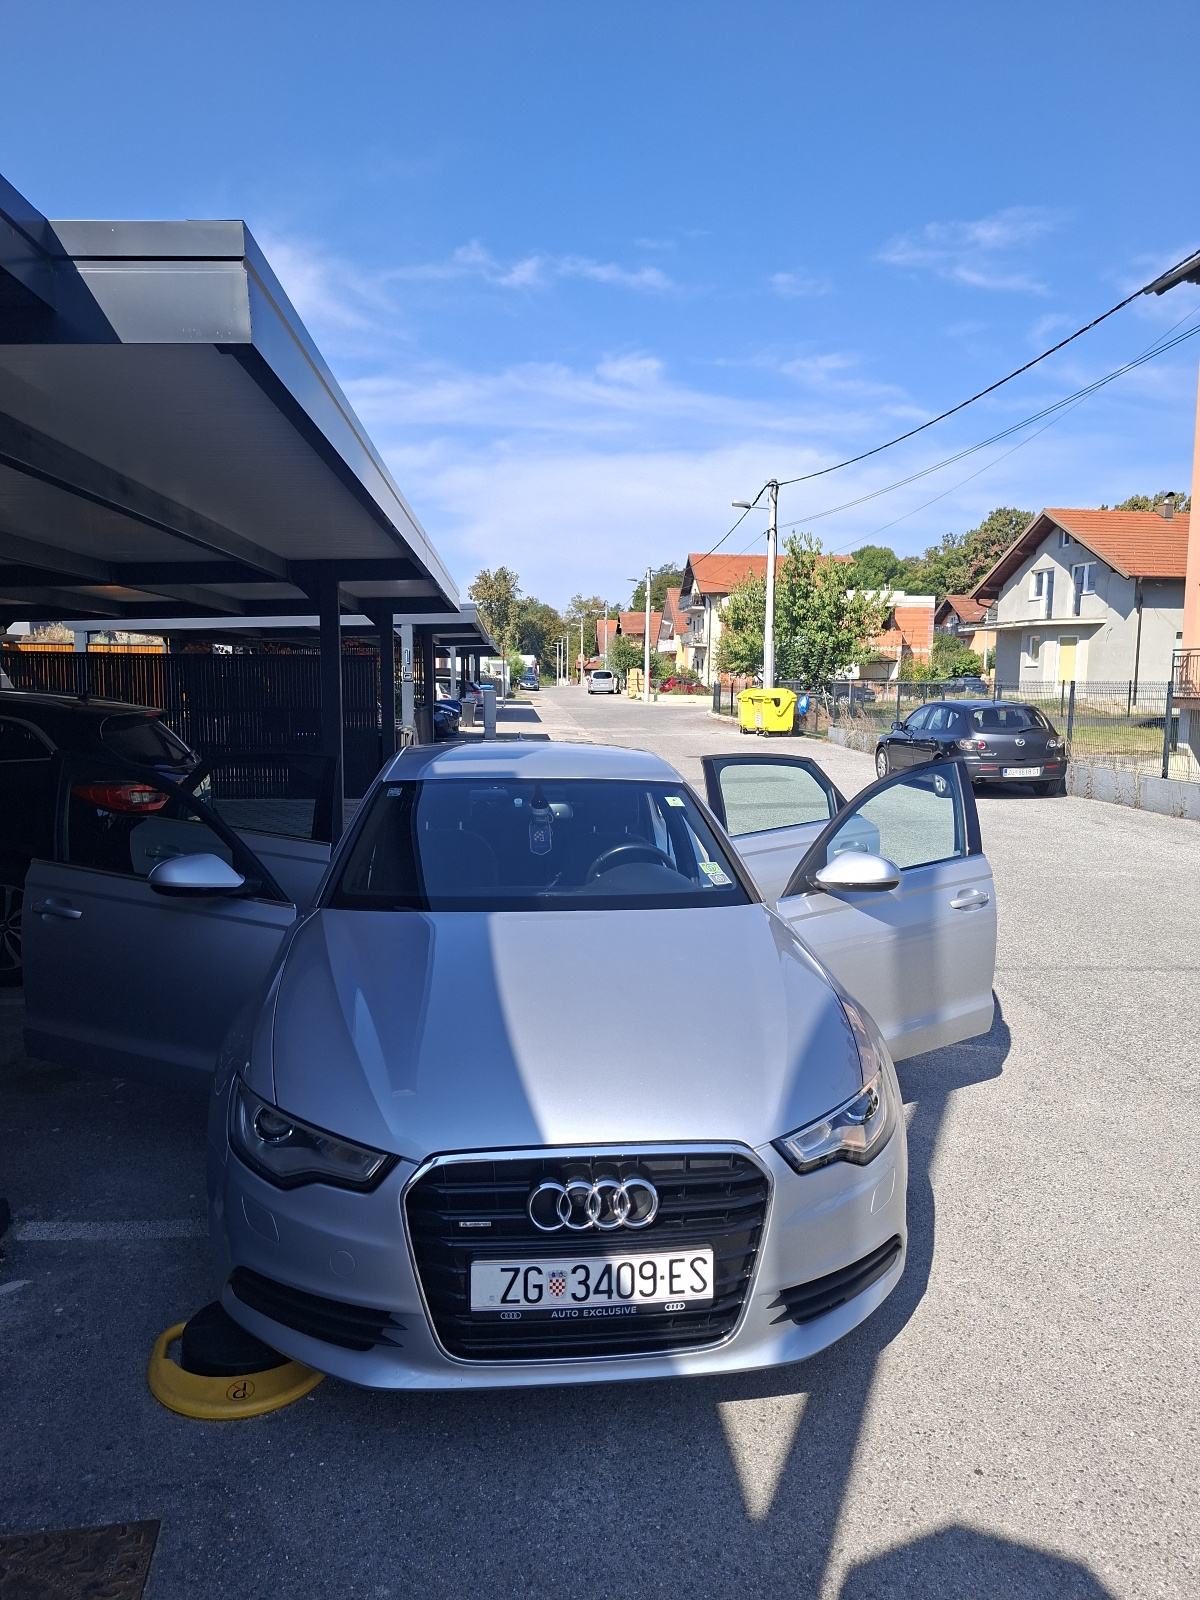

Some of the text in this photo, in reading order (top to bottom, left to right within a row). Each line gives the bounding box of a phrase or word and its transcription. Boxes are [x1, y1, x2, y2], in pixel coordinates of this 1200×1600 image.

[500, 1266, 543, 1304] ZG
[551, 1306, 637, 1318] AUTO EXCLUSIVE
